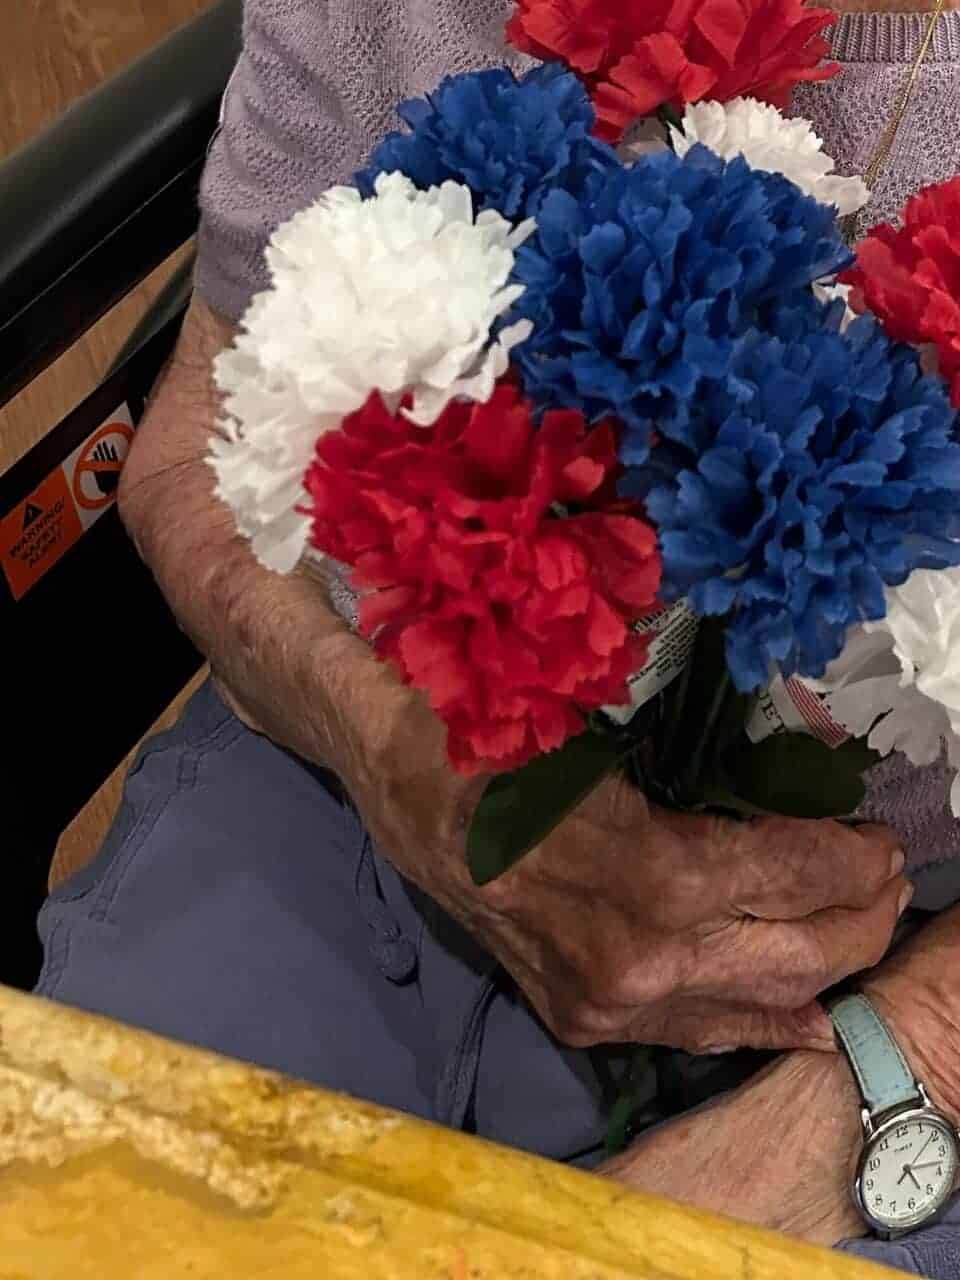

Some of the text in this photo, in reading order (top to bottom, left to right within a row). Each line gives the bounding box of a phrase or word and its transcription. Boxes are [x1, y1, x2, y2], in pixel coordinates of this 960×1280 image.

[896, 1125, 909, 1138] 12
[931, 1130, 939, 1142] 2
[938, 1145, 946, 1158] 3
[869, 1157, 880, 1171] 10
[866, 1179, 874, 1190] 9
[927, 1184, 934, 1195] 5
[875, 1194, 883, 1206] 8
[908, 1198, 916, 1210] 6
[889, 1200, 897, 1213] 7
